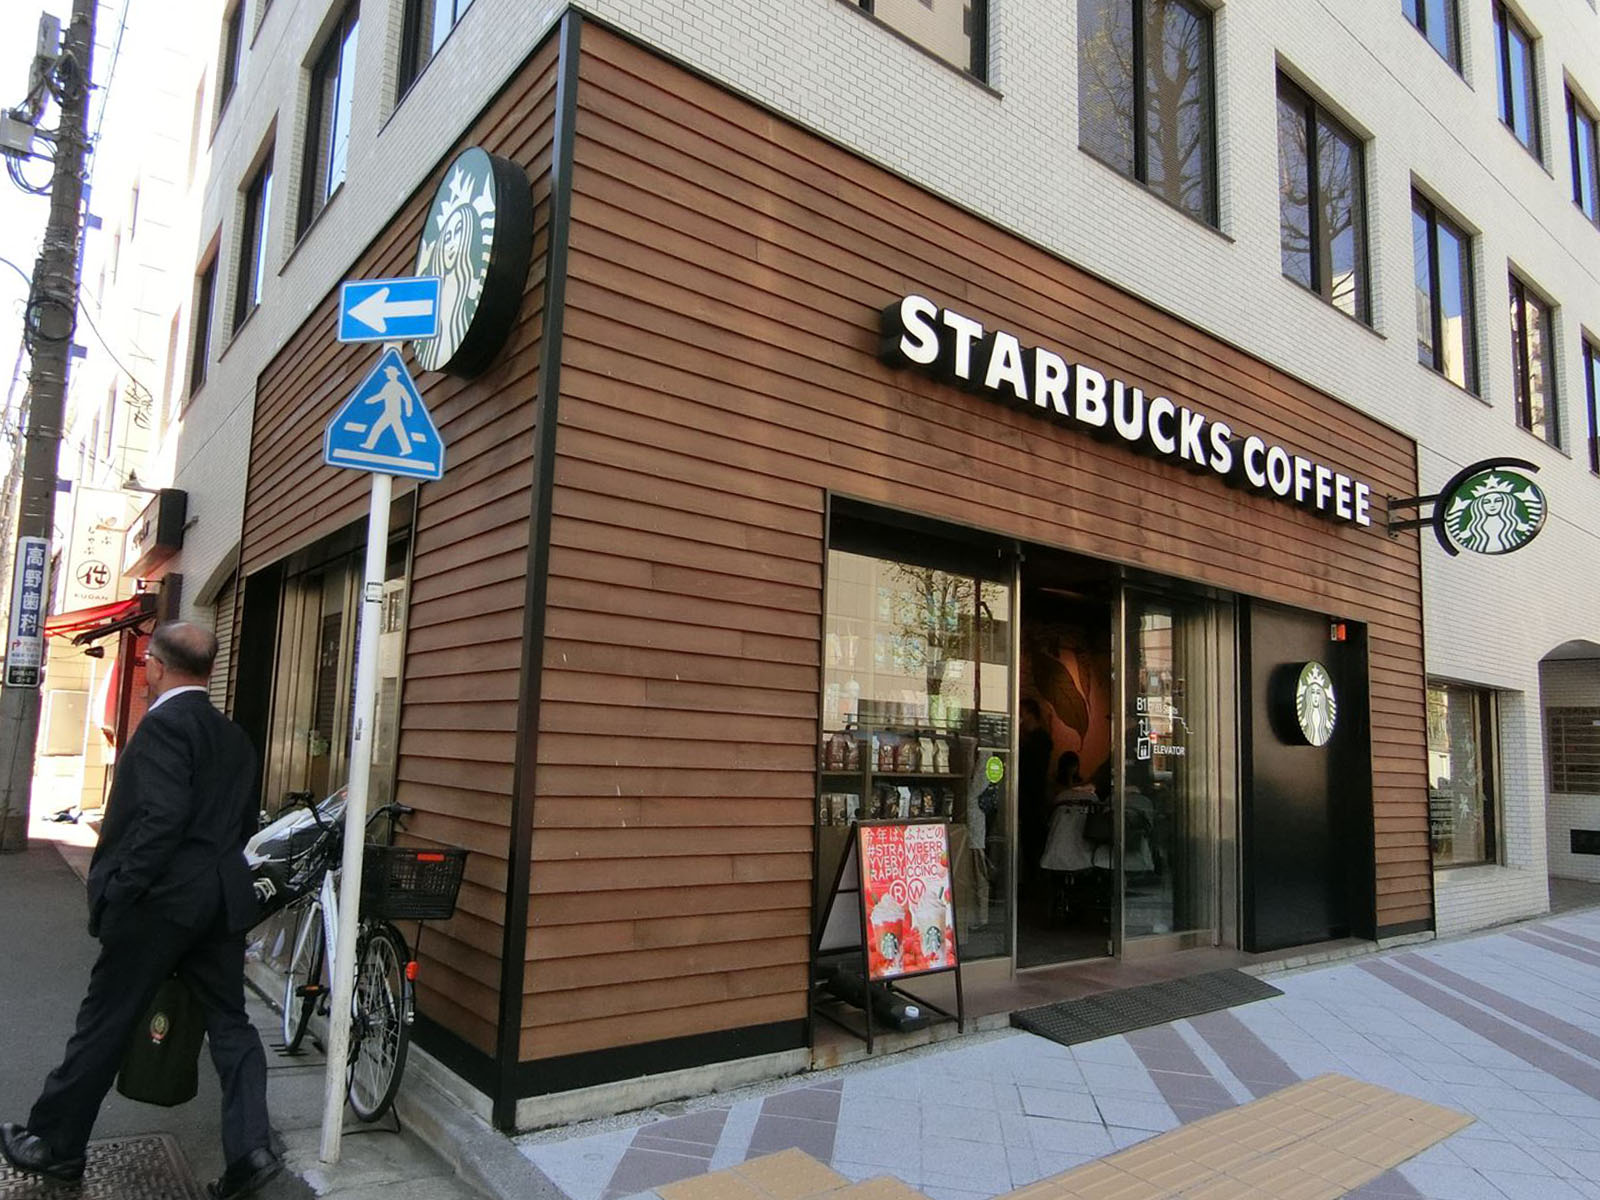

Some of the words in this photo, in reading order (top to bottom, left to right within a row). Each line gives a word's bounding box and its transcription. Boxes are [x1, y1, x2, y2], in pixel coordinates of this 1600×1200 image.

[900, 294, 1233, 475] STARBUCKS
[1243, 435, 1371, 528] COFFEE
[19, 546, 45, 633] 高野歯科
[1153, 744, 1185, 755] ELEVATOR
